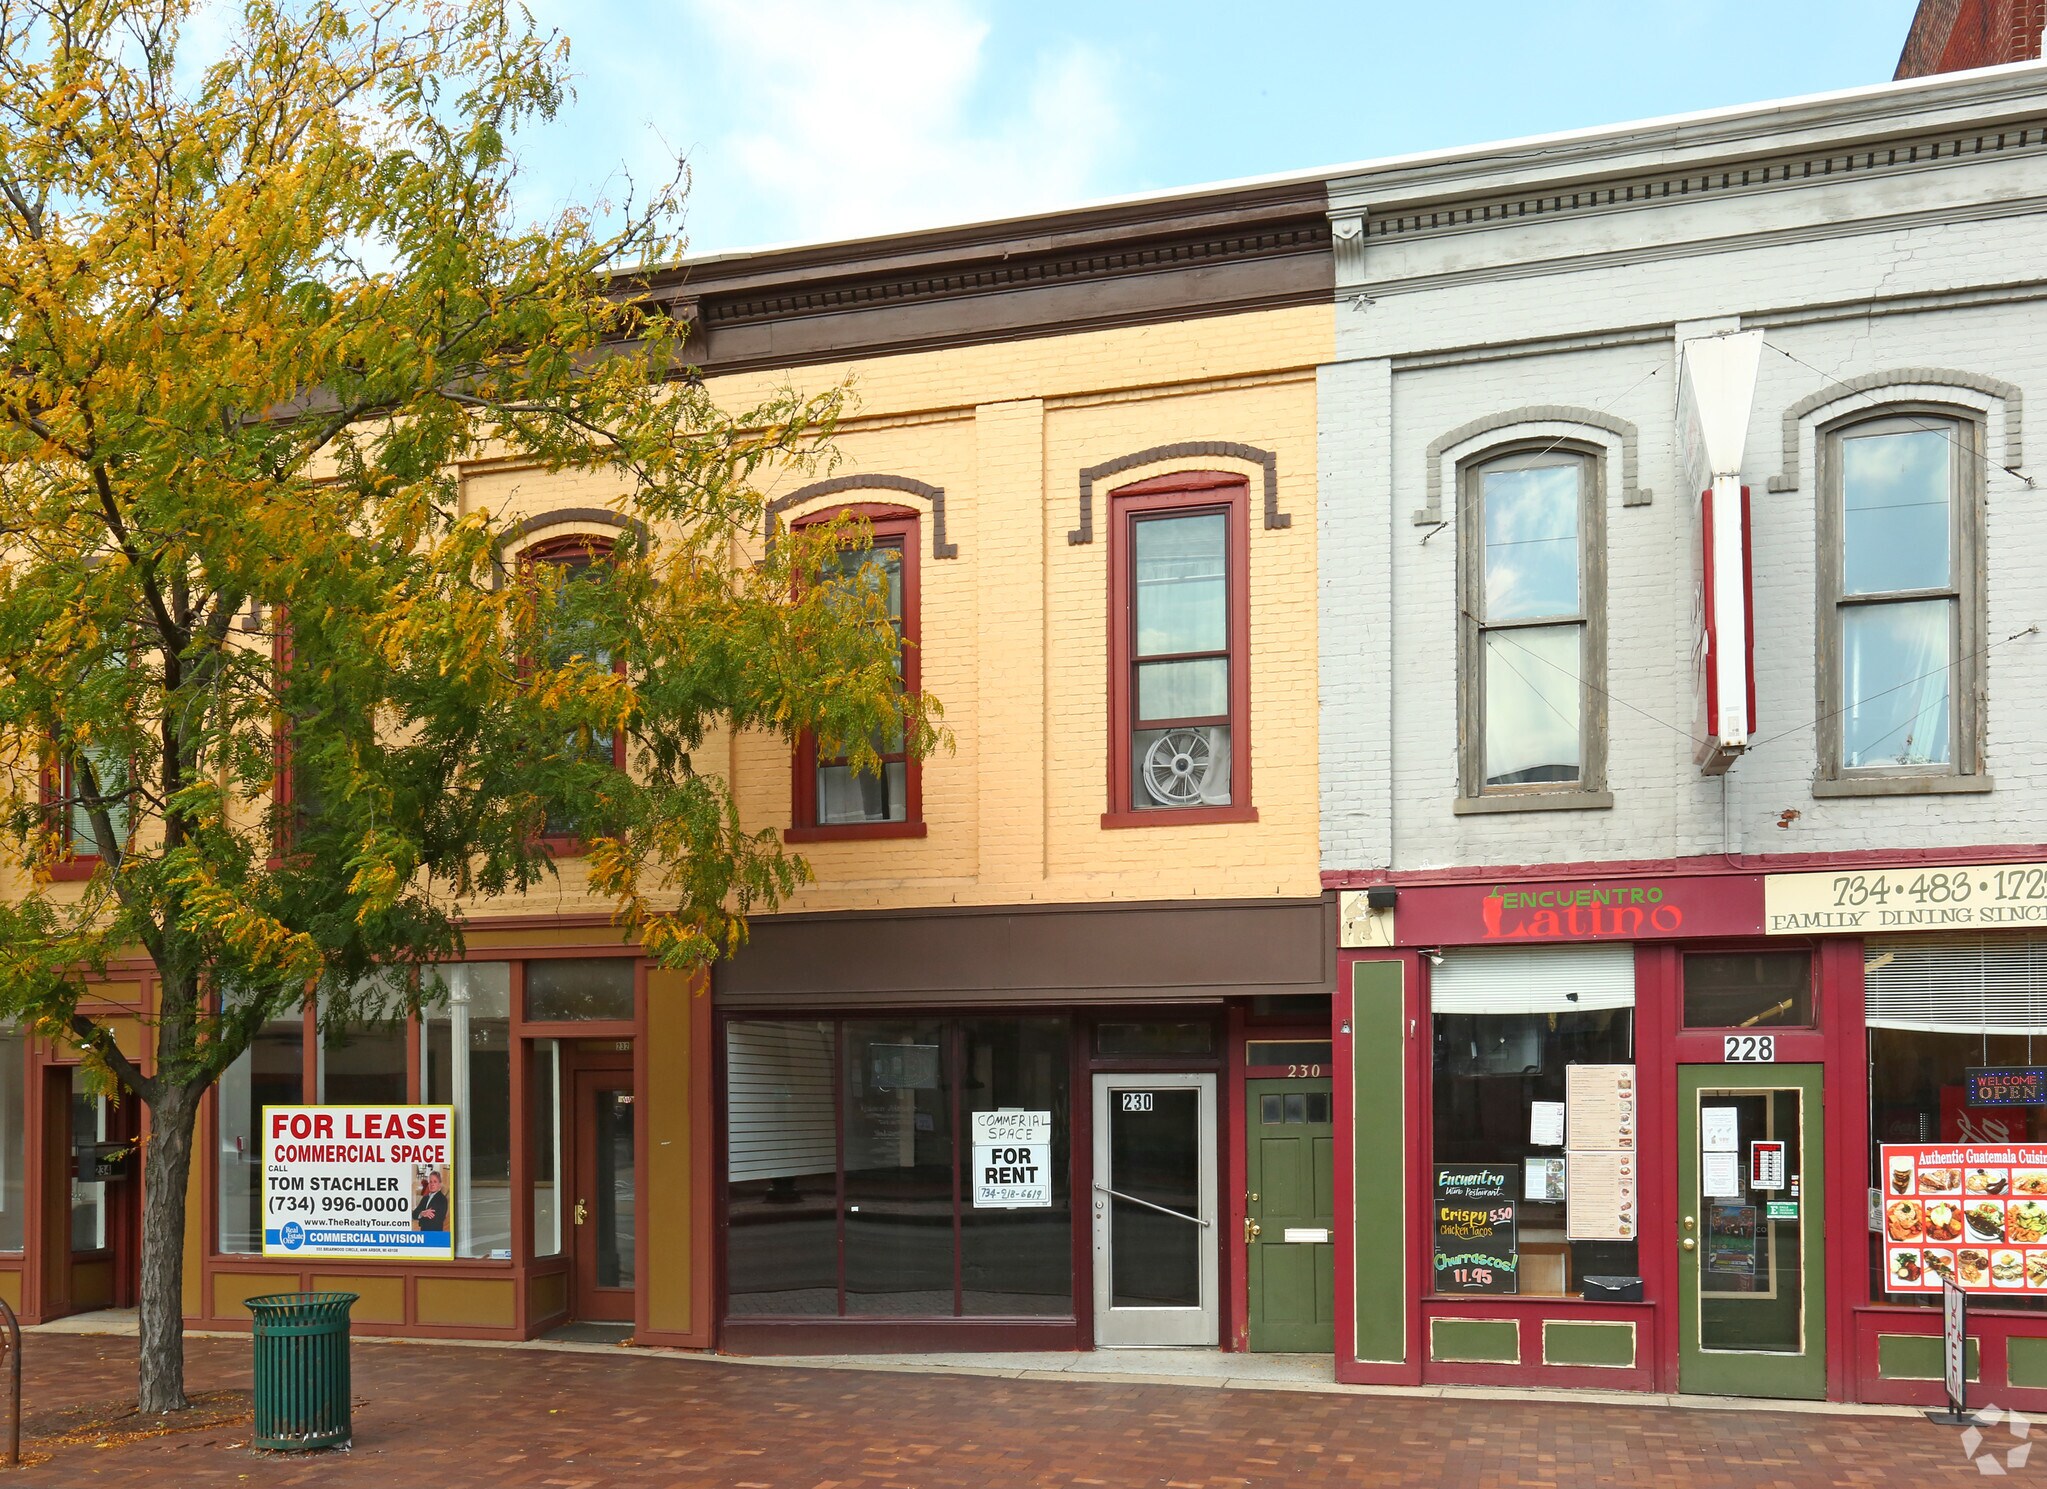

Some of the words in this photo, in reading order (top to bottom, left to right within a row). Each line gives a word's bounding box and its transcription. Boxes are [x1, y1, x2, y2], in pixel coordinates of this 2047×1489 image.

[1503, 887, 1663, 909] ENCUENTRO
[1482, 896, 1682, 939] Latino
[1770, 911, 1870, 931] FAMILY
[1878, 907, 1974, 926] DINING
[1726, 1036, 1772, 1061] 228
[1288, 1064, 1320, 1078] 230
[1977, 1075, 2037, 1086] WELCOME
[1978, 1085, 2037, 1100] OPEN
[1124, 1093, 1152, 1111] 230
[272, 1114, 334, 1139] FOR
[345, 1113, 447, 1139] LEASE
[988, 1127, 1033, 1140] SPACE
[274, 1144, 385, 1163] COMMERCIAL
[391, 1144, 445, 1163] SPACE
[991, 1147, 1031, 1165] FOR
[1918, 1150, 1965, 1165] Authentic
[1965, 1148, 2017, 1165] Guatemala
[268, 1164, 288, 1172] CALL
[985, 1166, 1038, 1184] RENT
[268, 1177, 304, 1191] TOM
[310, 1177, 399, 1191] STACHLER
[1439, 1169, 1504, 1187] Encuentro
[268, 1196, 315, 1215] (734)
[321, 1196, 409, 1212] 996-0000
[1770, 1205, 1778, 1214] E
[304, 1218, 410, 1227] www.TheRealtyTour.com
[1441, 1207, 1487, 1228] Crispy
[286, 1226, 298, 1234] Real
[309, 1233, 377, 1243] COMMERCIAL
[379, 1233, 424, 1244] DIVISION
[1440, 1223, 1469, 1237] Chicken
[1470, 1225, 1493, 1236] Tacos
[1434, 1252, 1519, 1273] Churrascos!
[1453, 1267, 1493, 1285] 11.95
